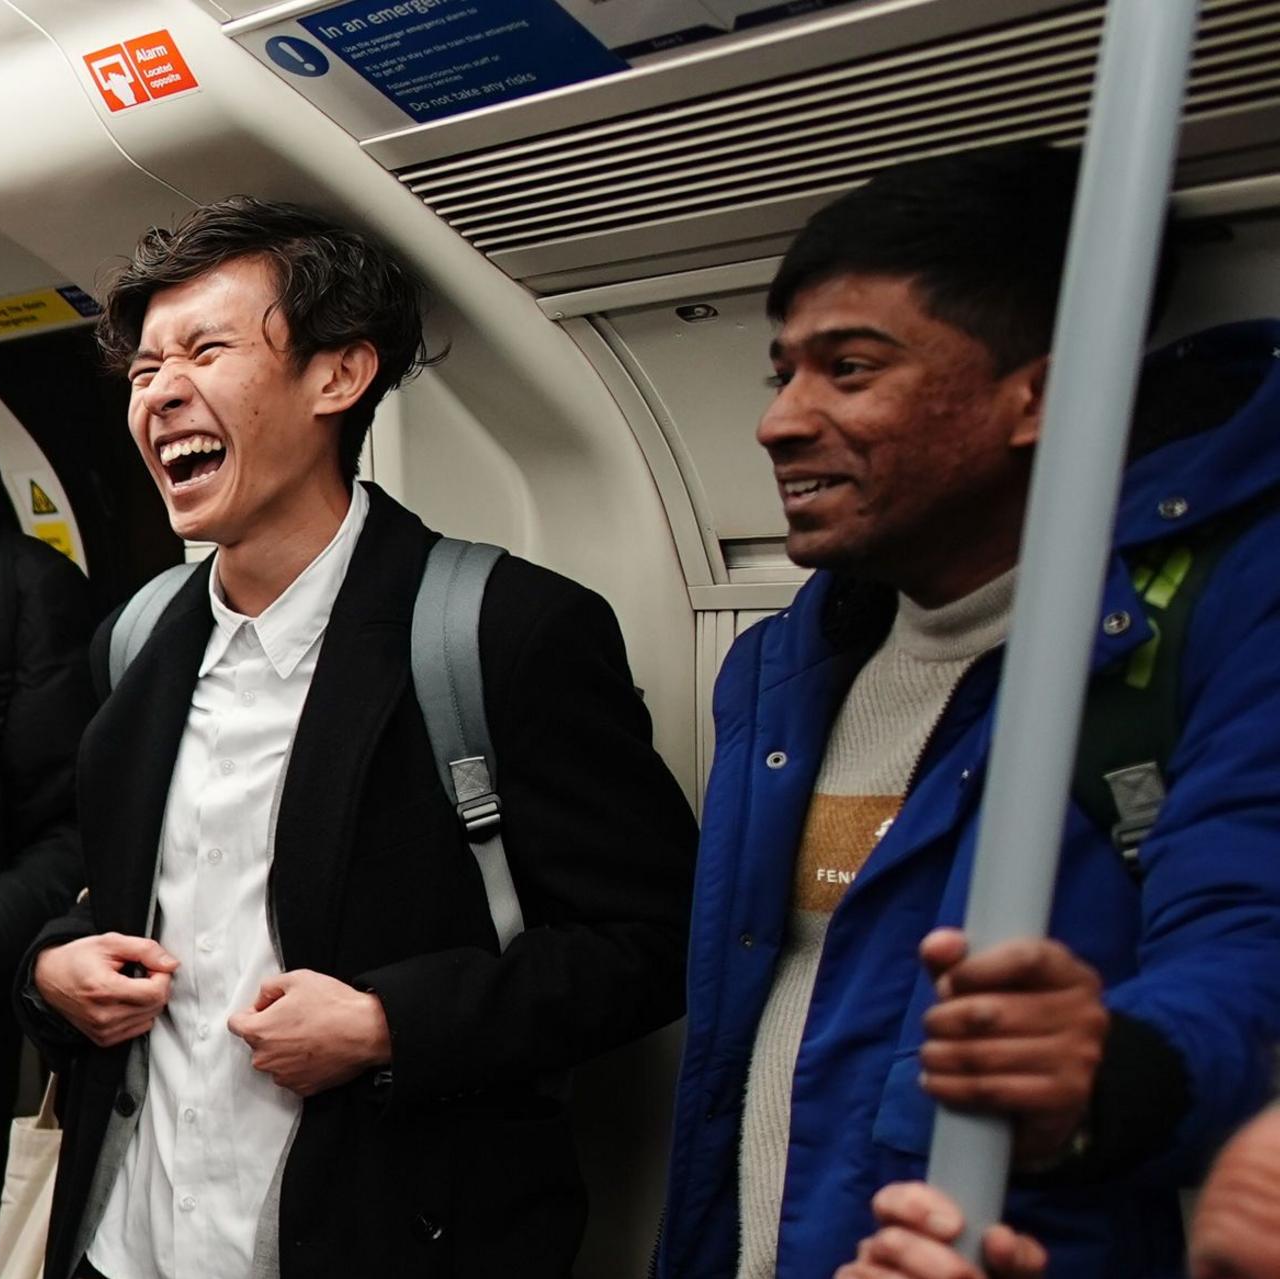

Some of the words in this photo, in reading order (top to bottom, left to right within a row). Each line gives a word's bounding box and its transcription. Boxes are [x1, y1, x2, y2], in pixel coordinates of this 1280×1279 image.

[318, 25, 343, 40] In
[342, 16, 368, 33] an
[406, 19, 445, 33] emergency
[136, 46, 168, 63] Alarm
[144, 63, 173, 78] Located
[151, 73, 181, 88] opposite
[409, 101, 430, 112] Do
[429, 94, 454, 108] not
[452, 87, 482, 101] take
[480, 80, 506, 95] any
